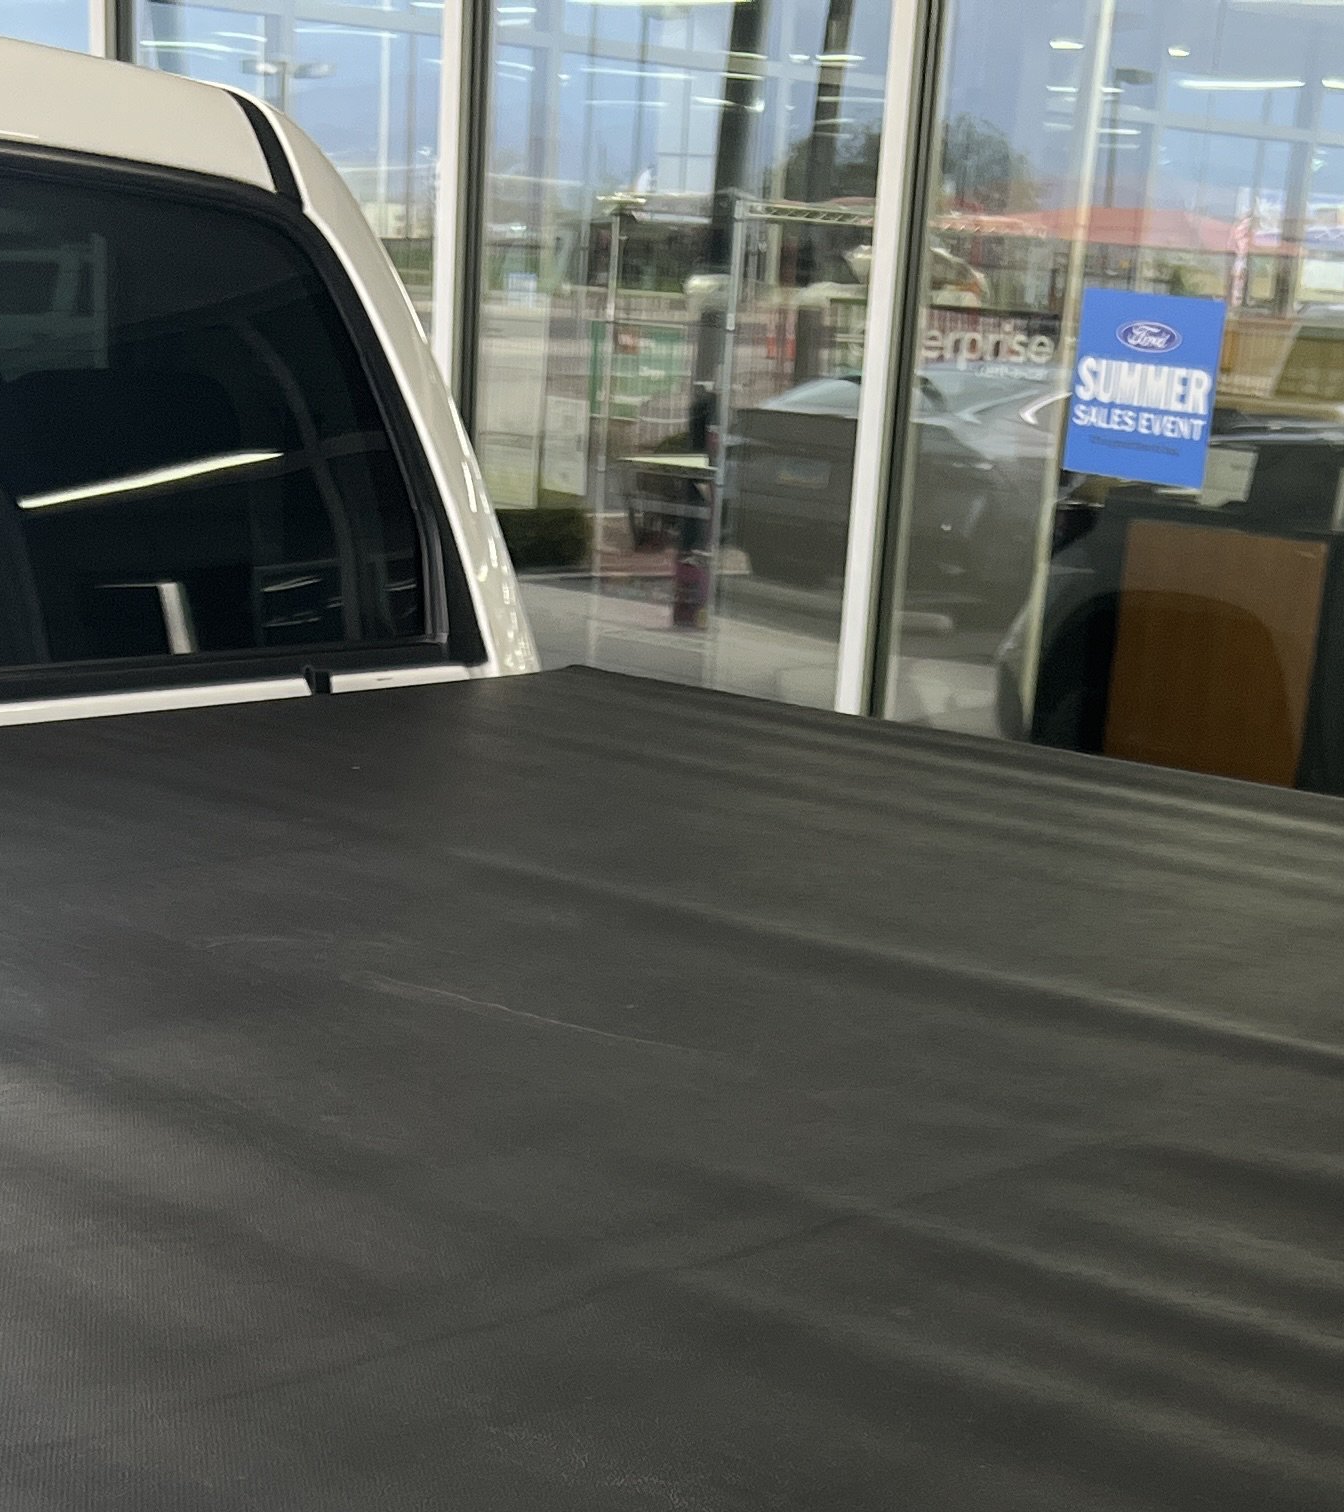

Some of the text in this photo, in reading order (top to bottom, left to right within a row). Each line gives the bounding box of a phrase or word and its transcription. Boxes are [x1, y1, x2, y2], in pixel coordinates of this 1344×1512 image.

[1124, 323, 1173, 349] Ford
[1075, 357, 1212, 415] SUMMER
[1072, 403, 1207, 441] SALES EVENT
